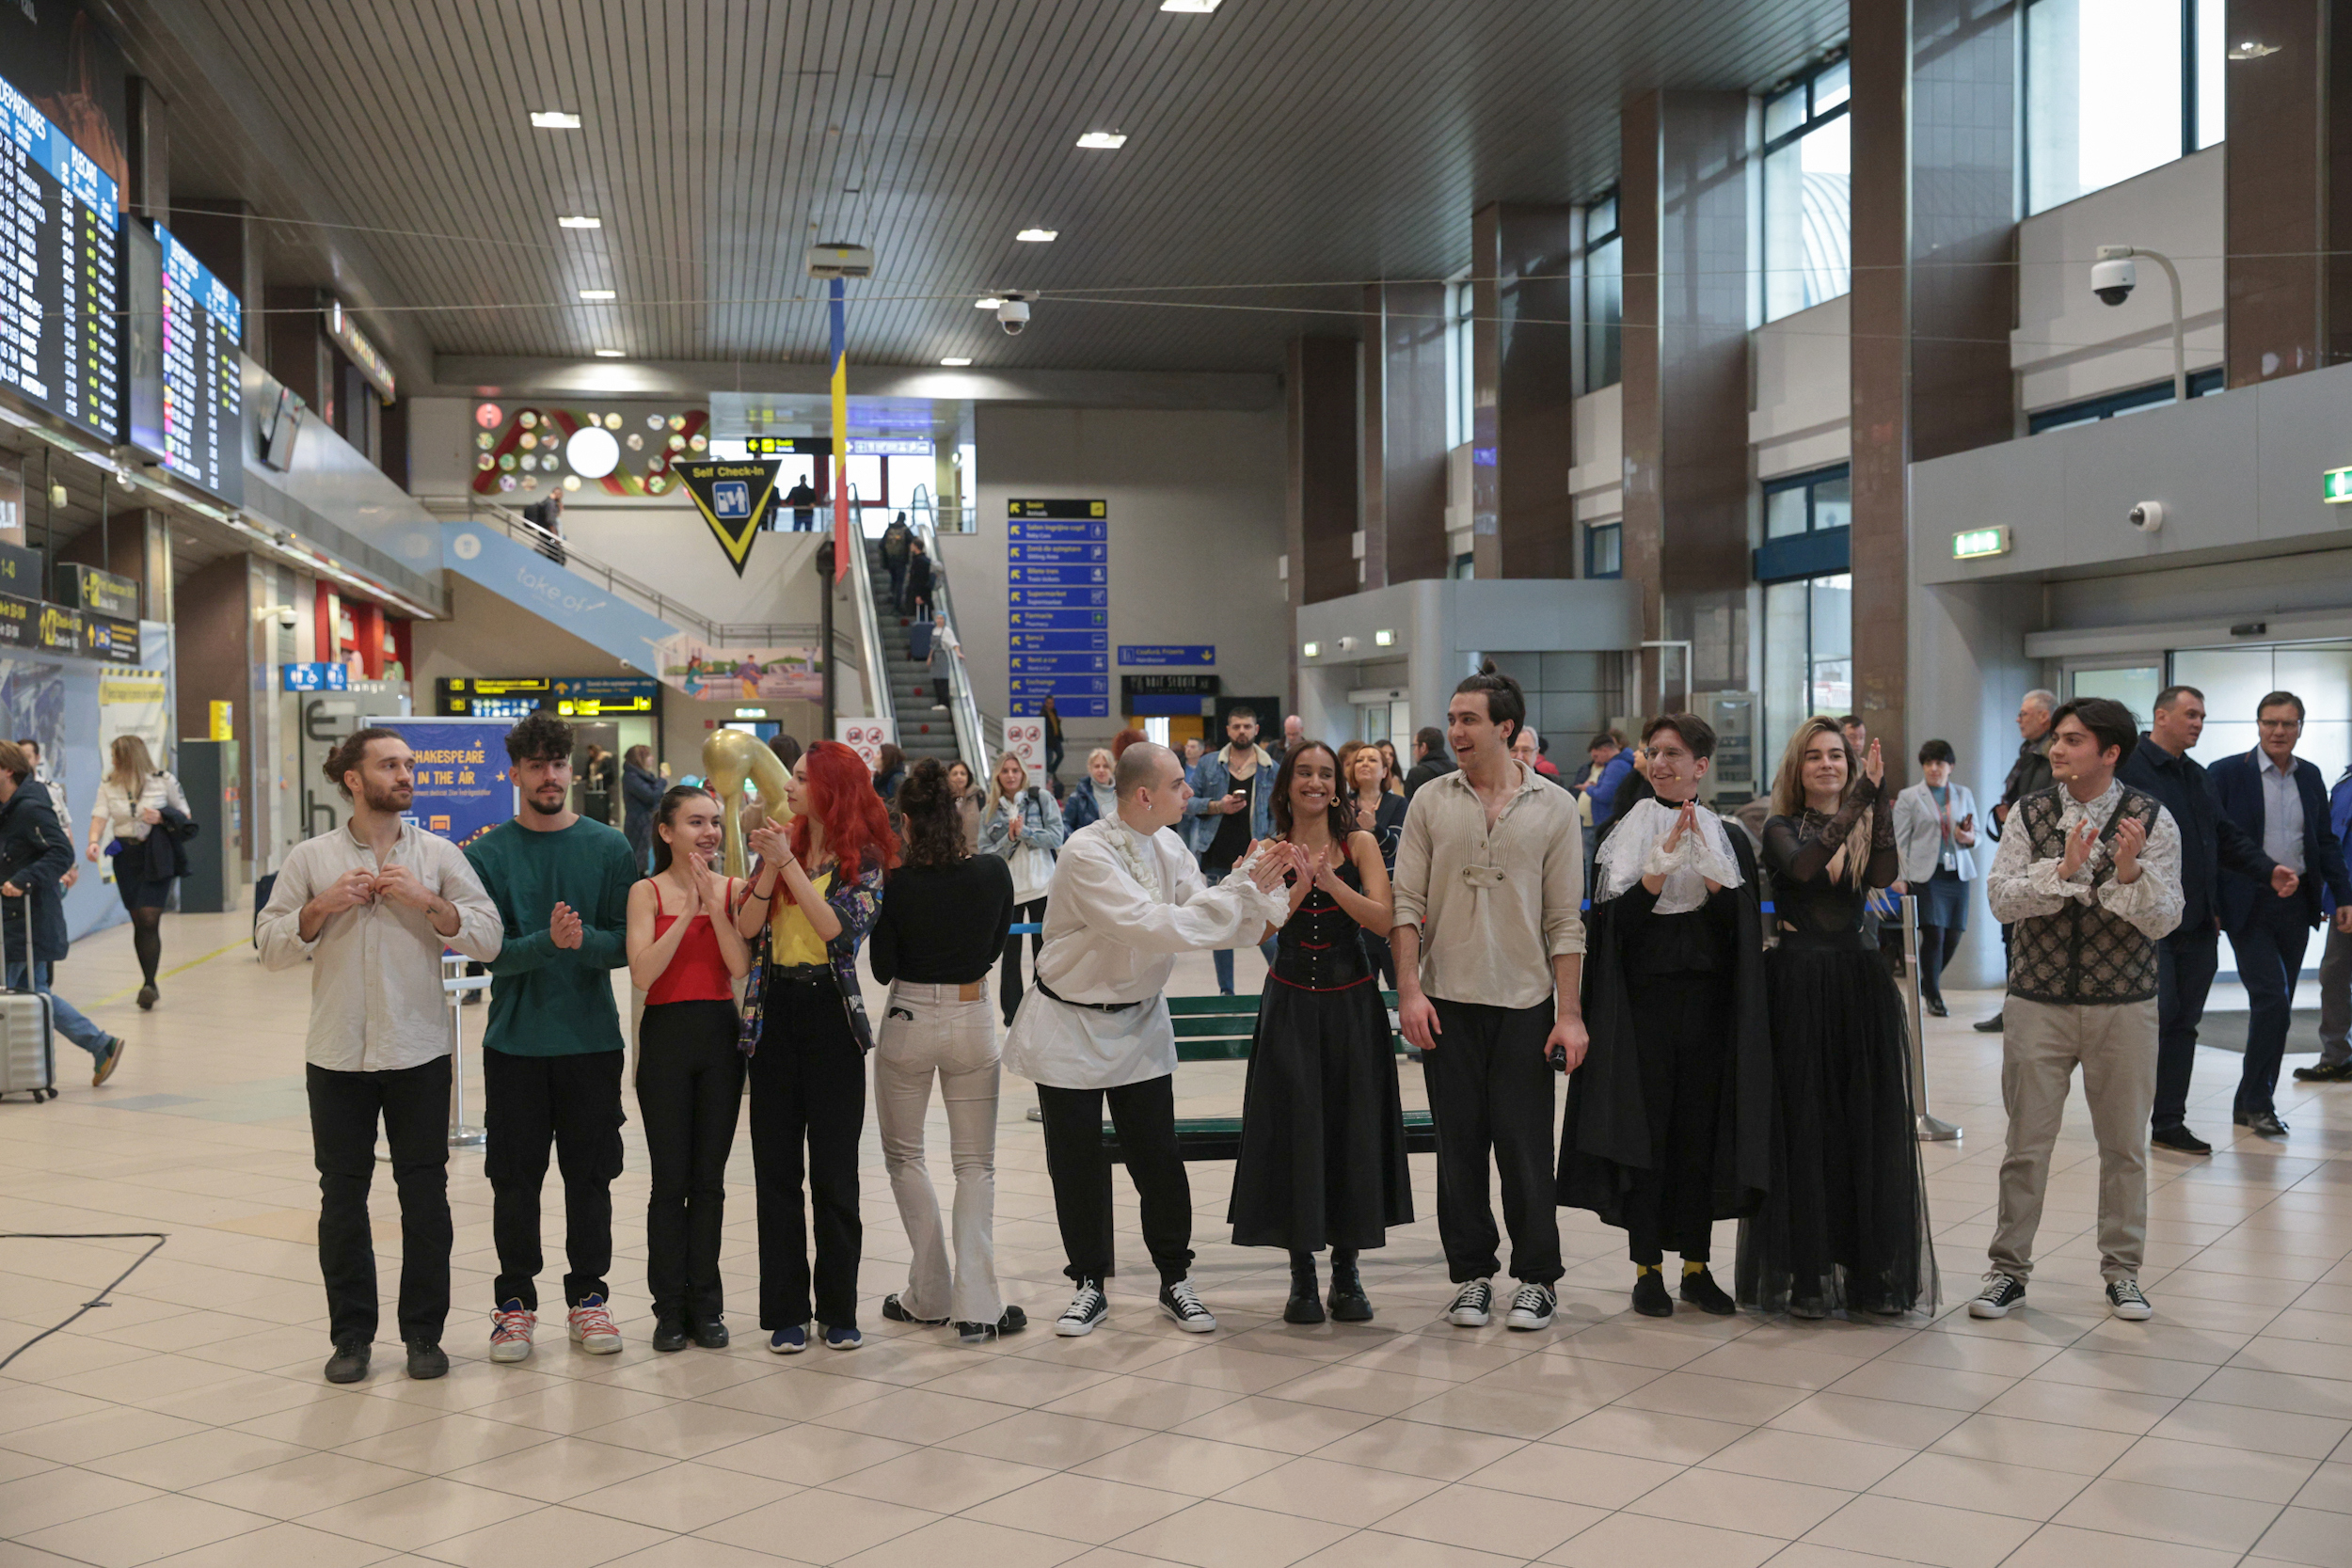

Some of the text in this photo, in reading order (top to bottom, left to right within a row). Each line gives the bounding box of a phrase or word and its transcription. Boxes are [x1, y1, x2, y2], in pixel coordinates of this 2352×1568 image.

[0, 76, 46, 140] DEPARTURES
[692, 467, 714, 478] Self
[517, 565, 562, 600] take
[296, 663, 311, 672] WC
[411, 750, 485, 764] SHAKESPEARE
[417, 770, 475, 784] IN THE AIR
